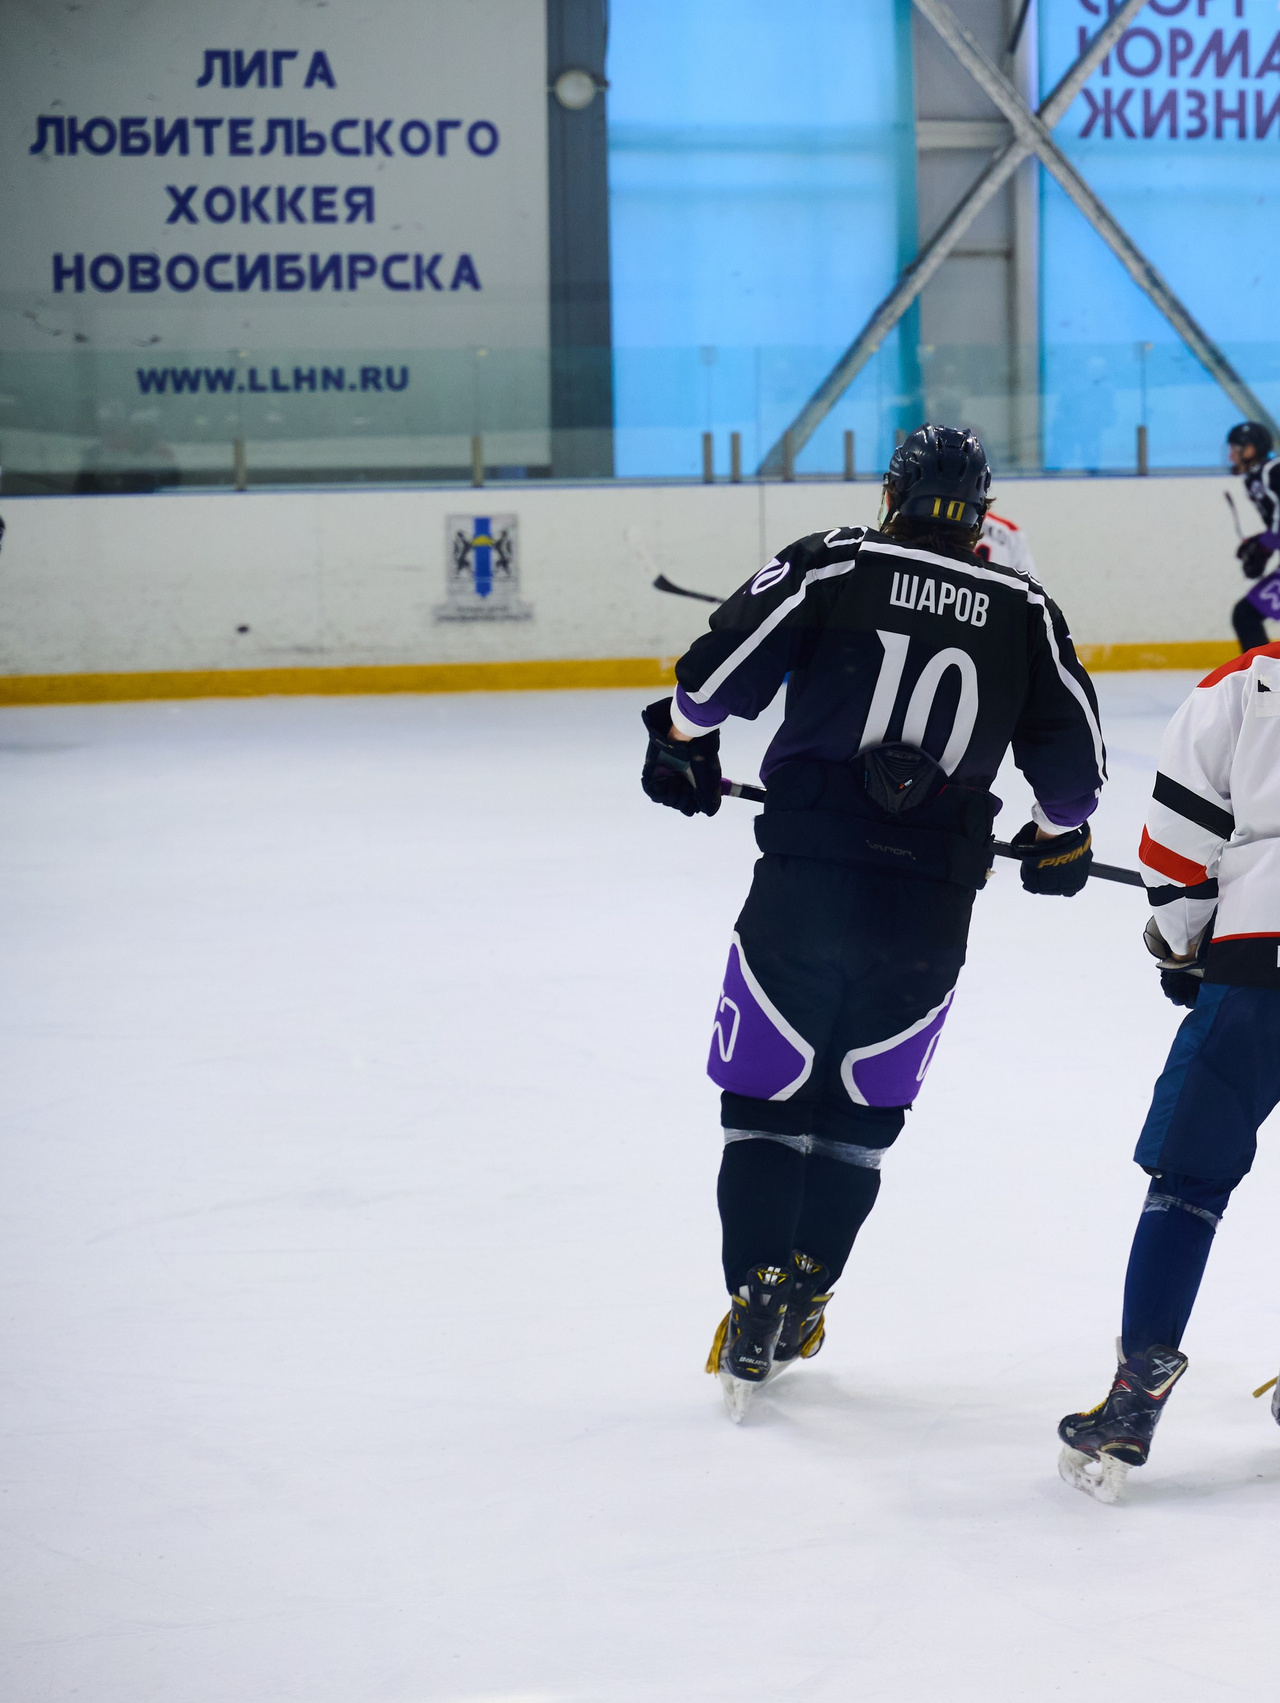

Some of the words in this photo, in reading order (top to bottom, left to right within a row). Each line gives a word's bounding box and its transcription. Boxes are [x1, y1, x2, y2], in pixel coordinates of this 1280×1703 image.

[196, 49, 337, 88] ЛИГА
[29, 116, 500, 157] ЛЮБИТЕЛЬСКОГО
[165, 185, 376, 225] ХОККЕЯ
[52, 253, 483, 293] НОВОСИБИРСКА
[136, 366, 410, 394] WWW.LLHN.RU
[930, 497, 966, 522] 10
[889, 571, 990, 628] ШАРОВ
[858, 629, 979, 778] 10
